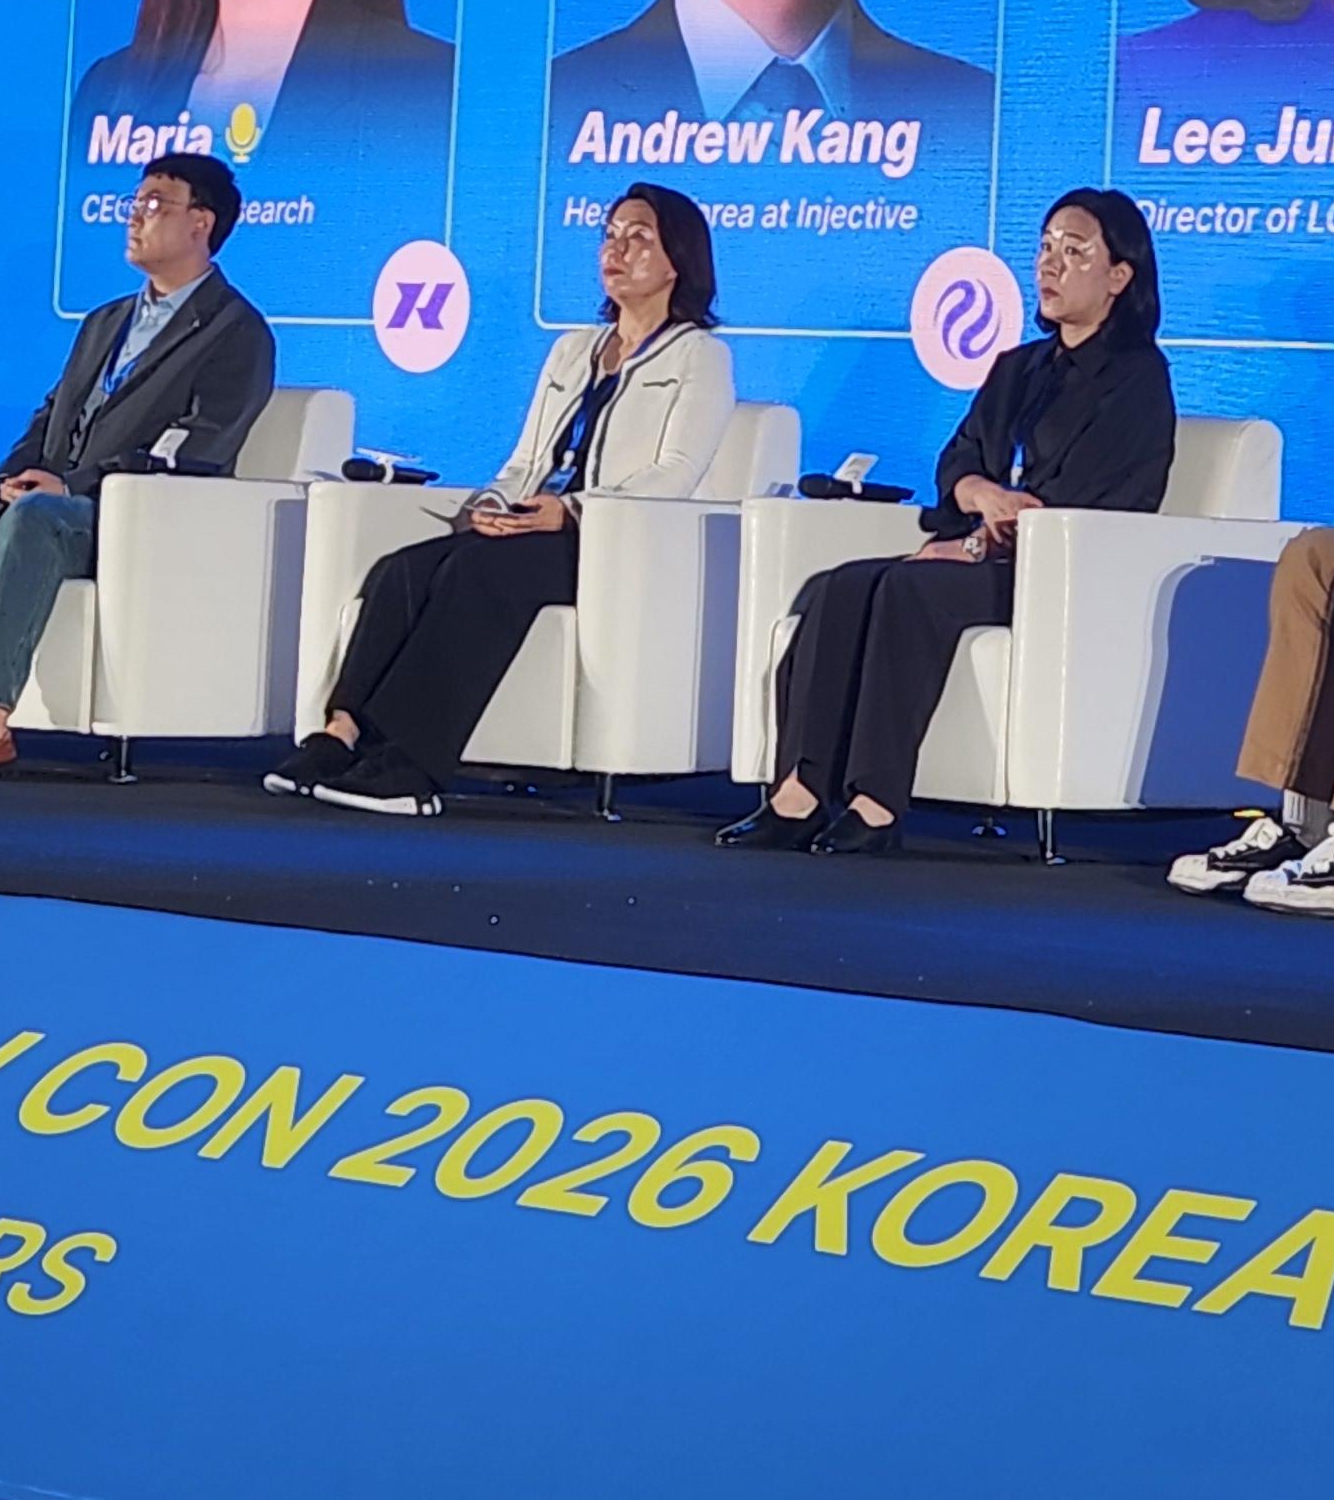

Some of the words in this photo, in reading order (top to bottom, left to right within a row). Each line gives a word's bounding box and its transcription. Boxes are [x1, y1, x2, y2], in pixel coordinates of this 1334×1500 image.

[87, 110, 214, 165] Maria
[568, 109, 774, 165] Andrew
[779, 108, 921, 179] Kang
[1138, 106, 1244, 165] Lee
[761, 197, 789, 229] at
[796, 196, 918, 236] Injective
[1135, 198, 1261, 235] Director
[1266, 199, 1303, 235] of
[15, 1041, 367, 1173] CON
[328, 1083, 762, 1231] 2026
